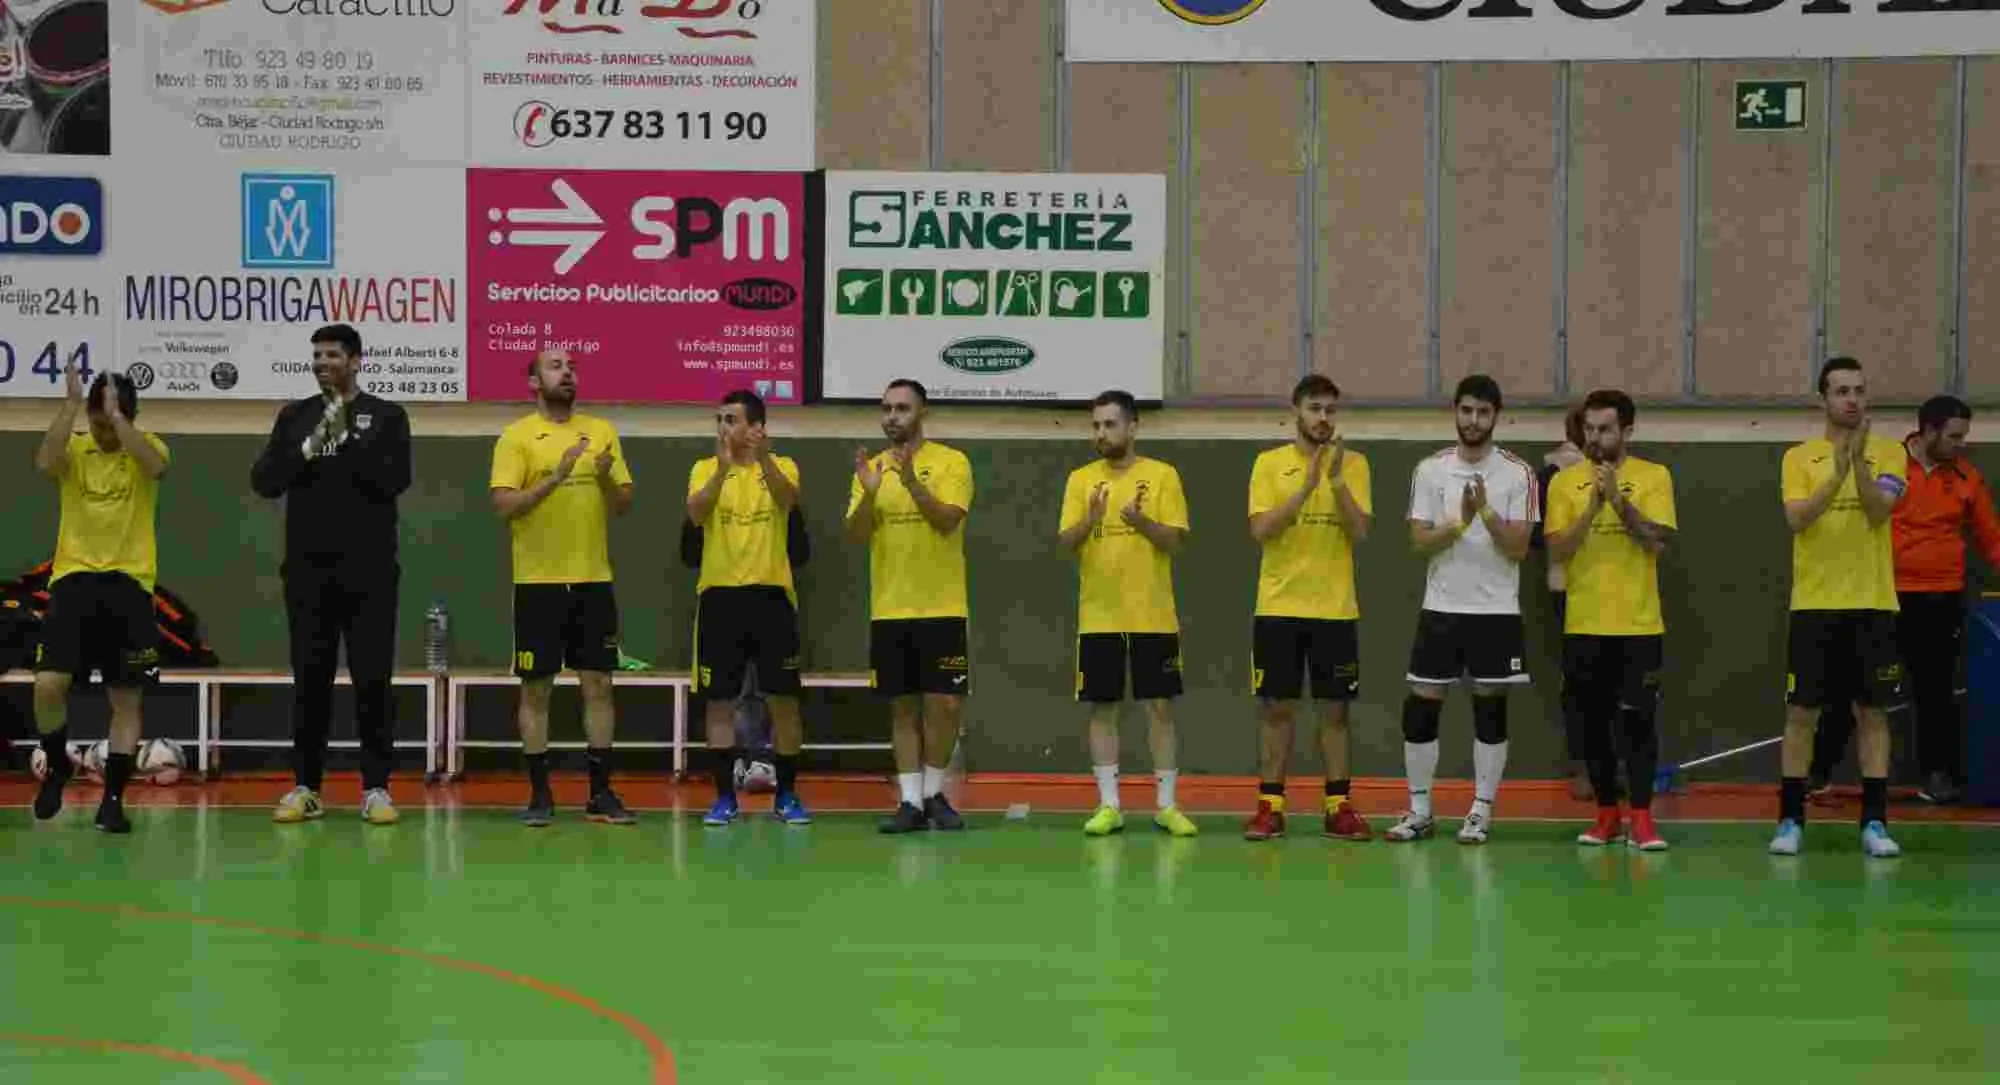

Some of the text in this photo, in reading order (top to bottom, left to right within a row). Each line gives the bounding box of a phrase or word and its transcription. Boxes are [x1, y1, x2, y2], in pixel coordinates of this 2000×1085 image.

[256, 49, 288, 70] 923
[527, 52, 592, 65] PINTURAS
[601, 53, 664, 66] BARNICES
[669, 54, 754, 67] MAQUINARIA
[483, 72, 593, 86] REVESTIMIENTOS
[603, 72, 703, 87] HERRAMIENTAS
[550, 109, 767, 139] 637 83 11 90
[45, 287, 99, 315] 24 h
[488, 322, 537, 336] Colada
[165, 341, 230, 355] Volkswagen
[361, 346, 391, 358] afael
[394, 346, 436, 358] Alberti
[368, 381, 394, 394] 923
[518, 651, 534, 671] 10
